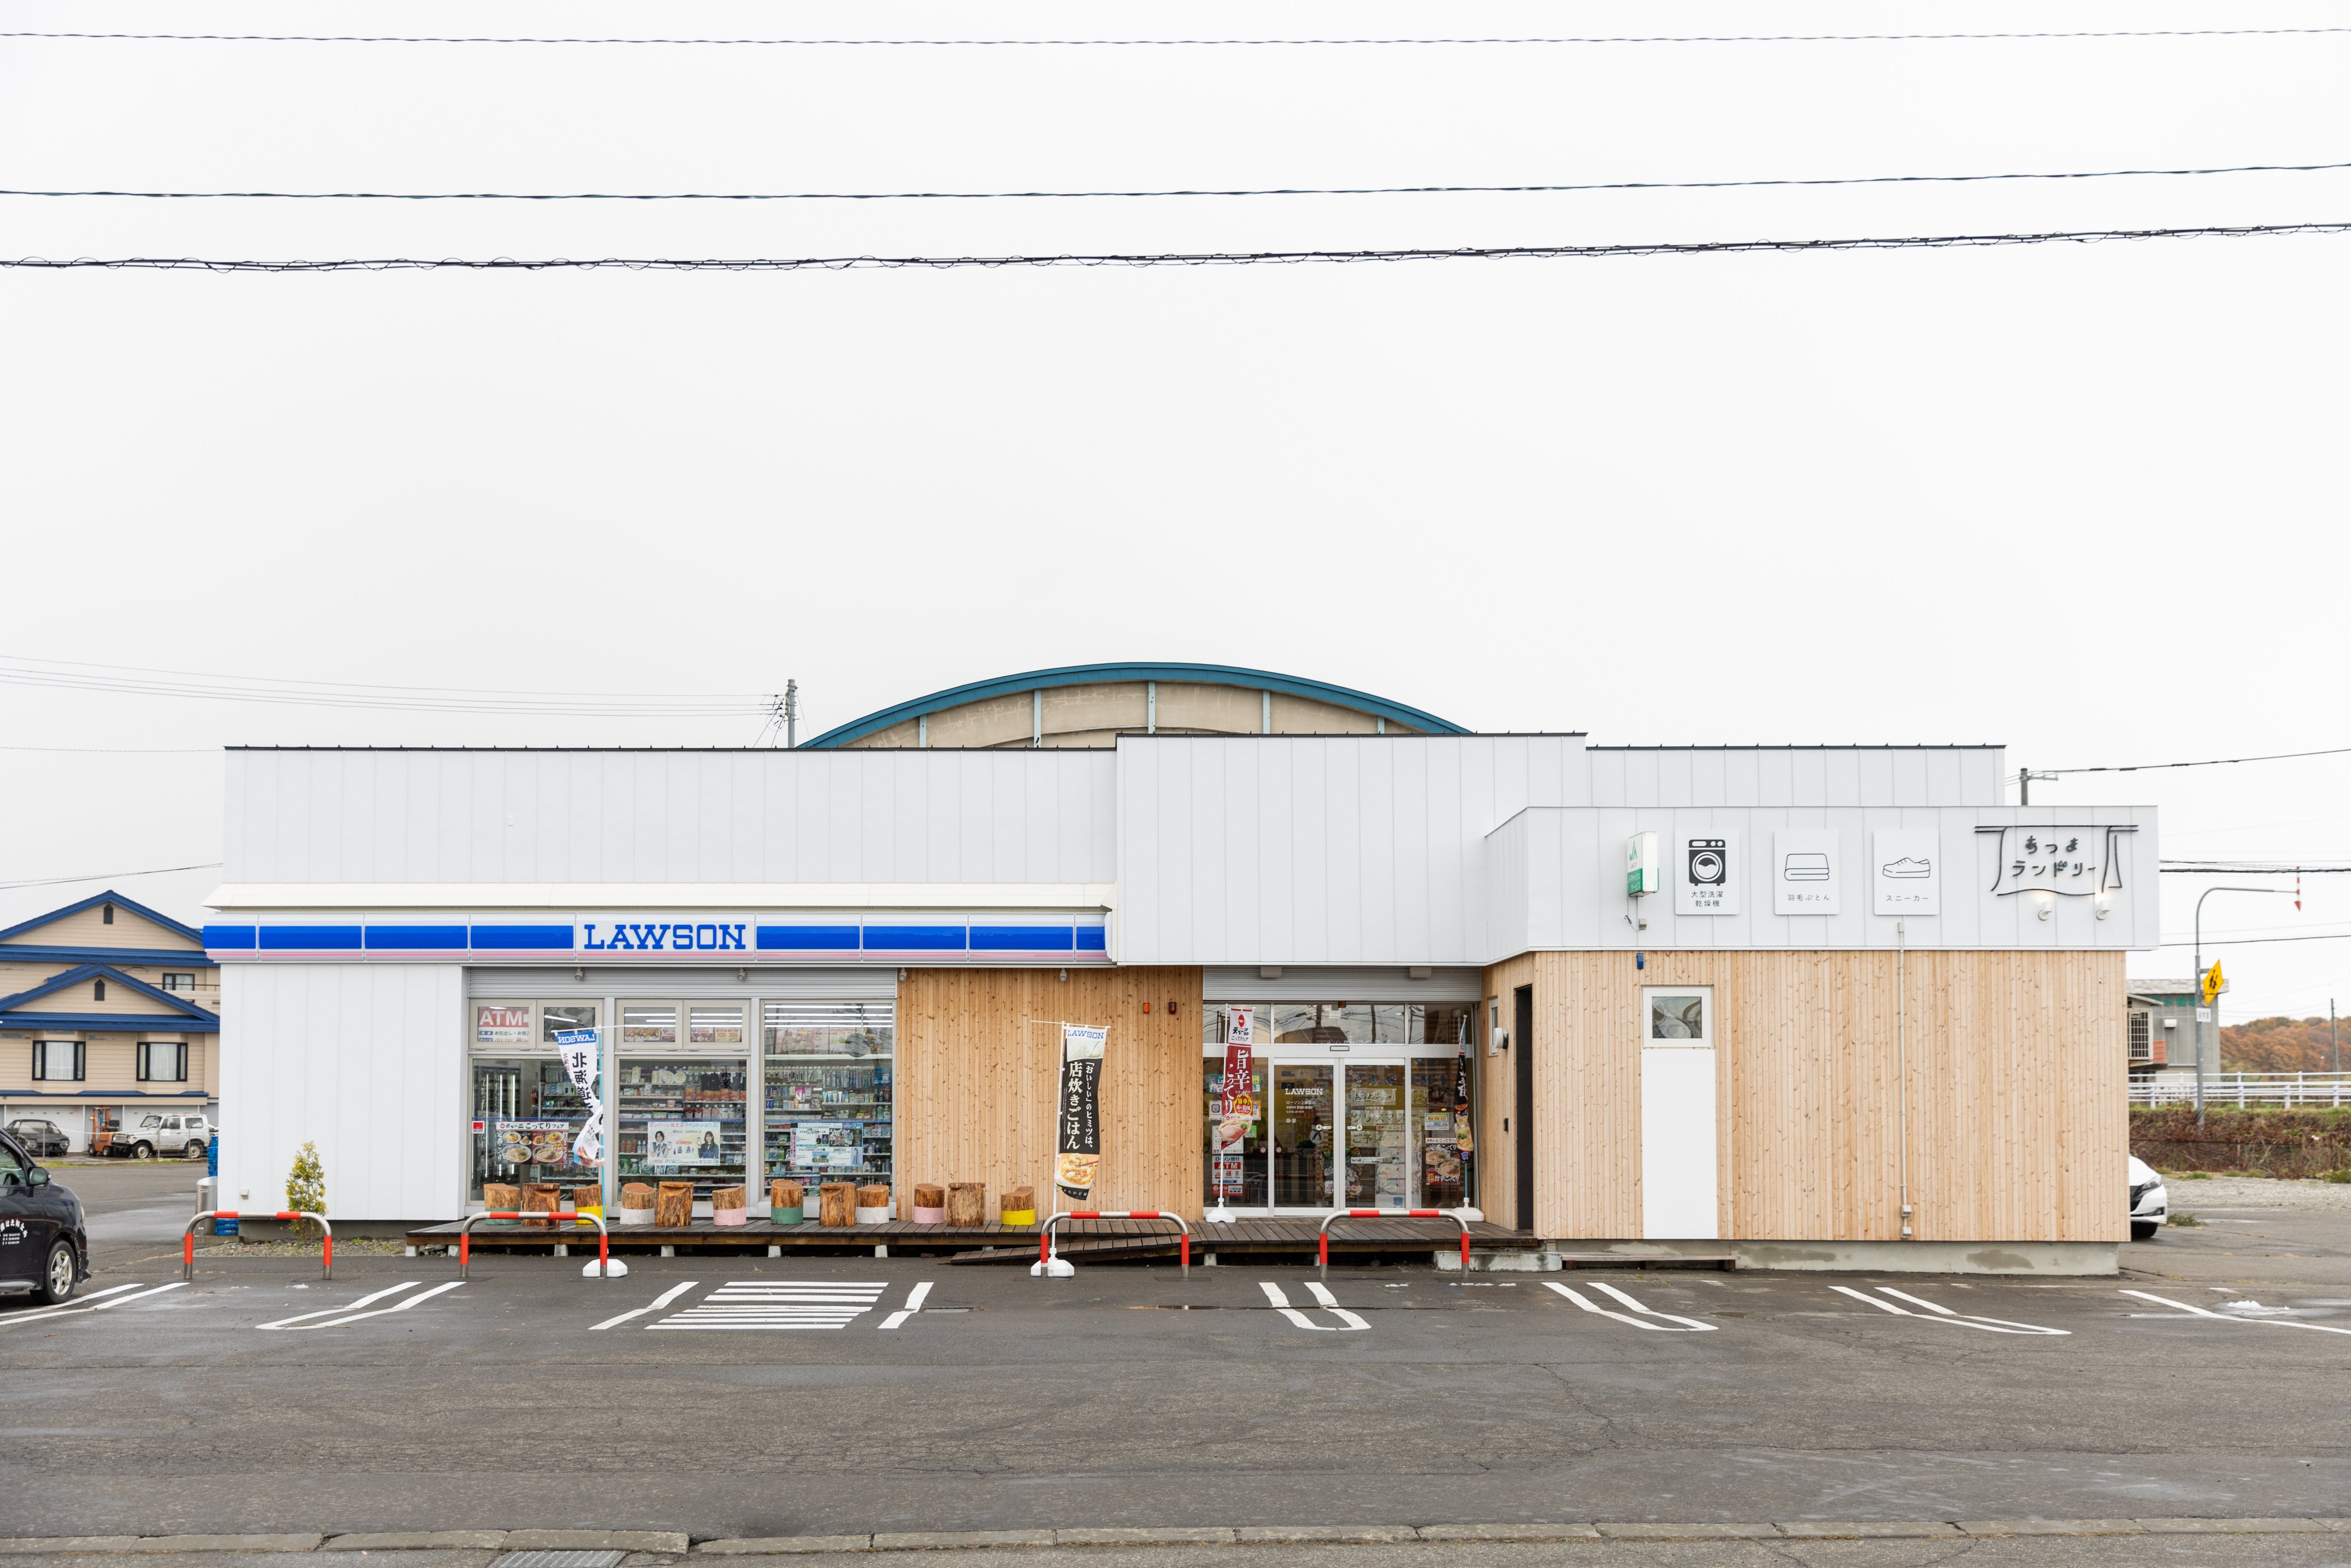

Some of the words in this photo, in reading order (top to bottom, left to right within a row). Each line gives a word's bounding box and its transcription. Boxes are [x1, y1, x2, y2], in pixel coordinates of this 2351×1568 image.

[2012, 860, 2096, 877] ランドリー
[584, 924, 746, 950] LAWSON
[479, 1010, 522, 1026] ATM
[1067, 1030, 1104, 1039] LAWSON
[1234, 1050, 1251, 1090] 旨辛
[1066, 1061, 1083, 1149] 店炊きごはん
